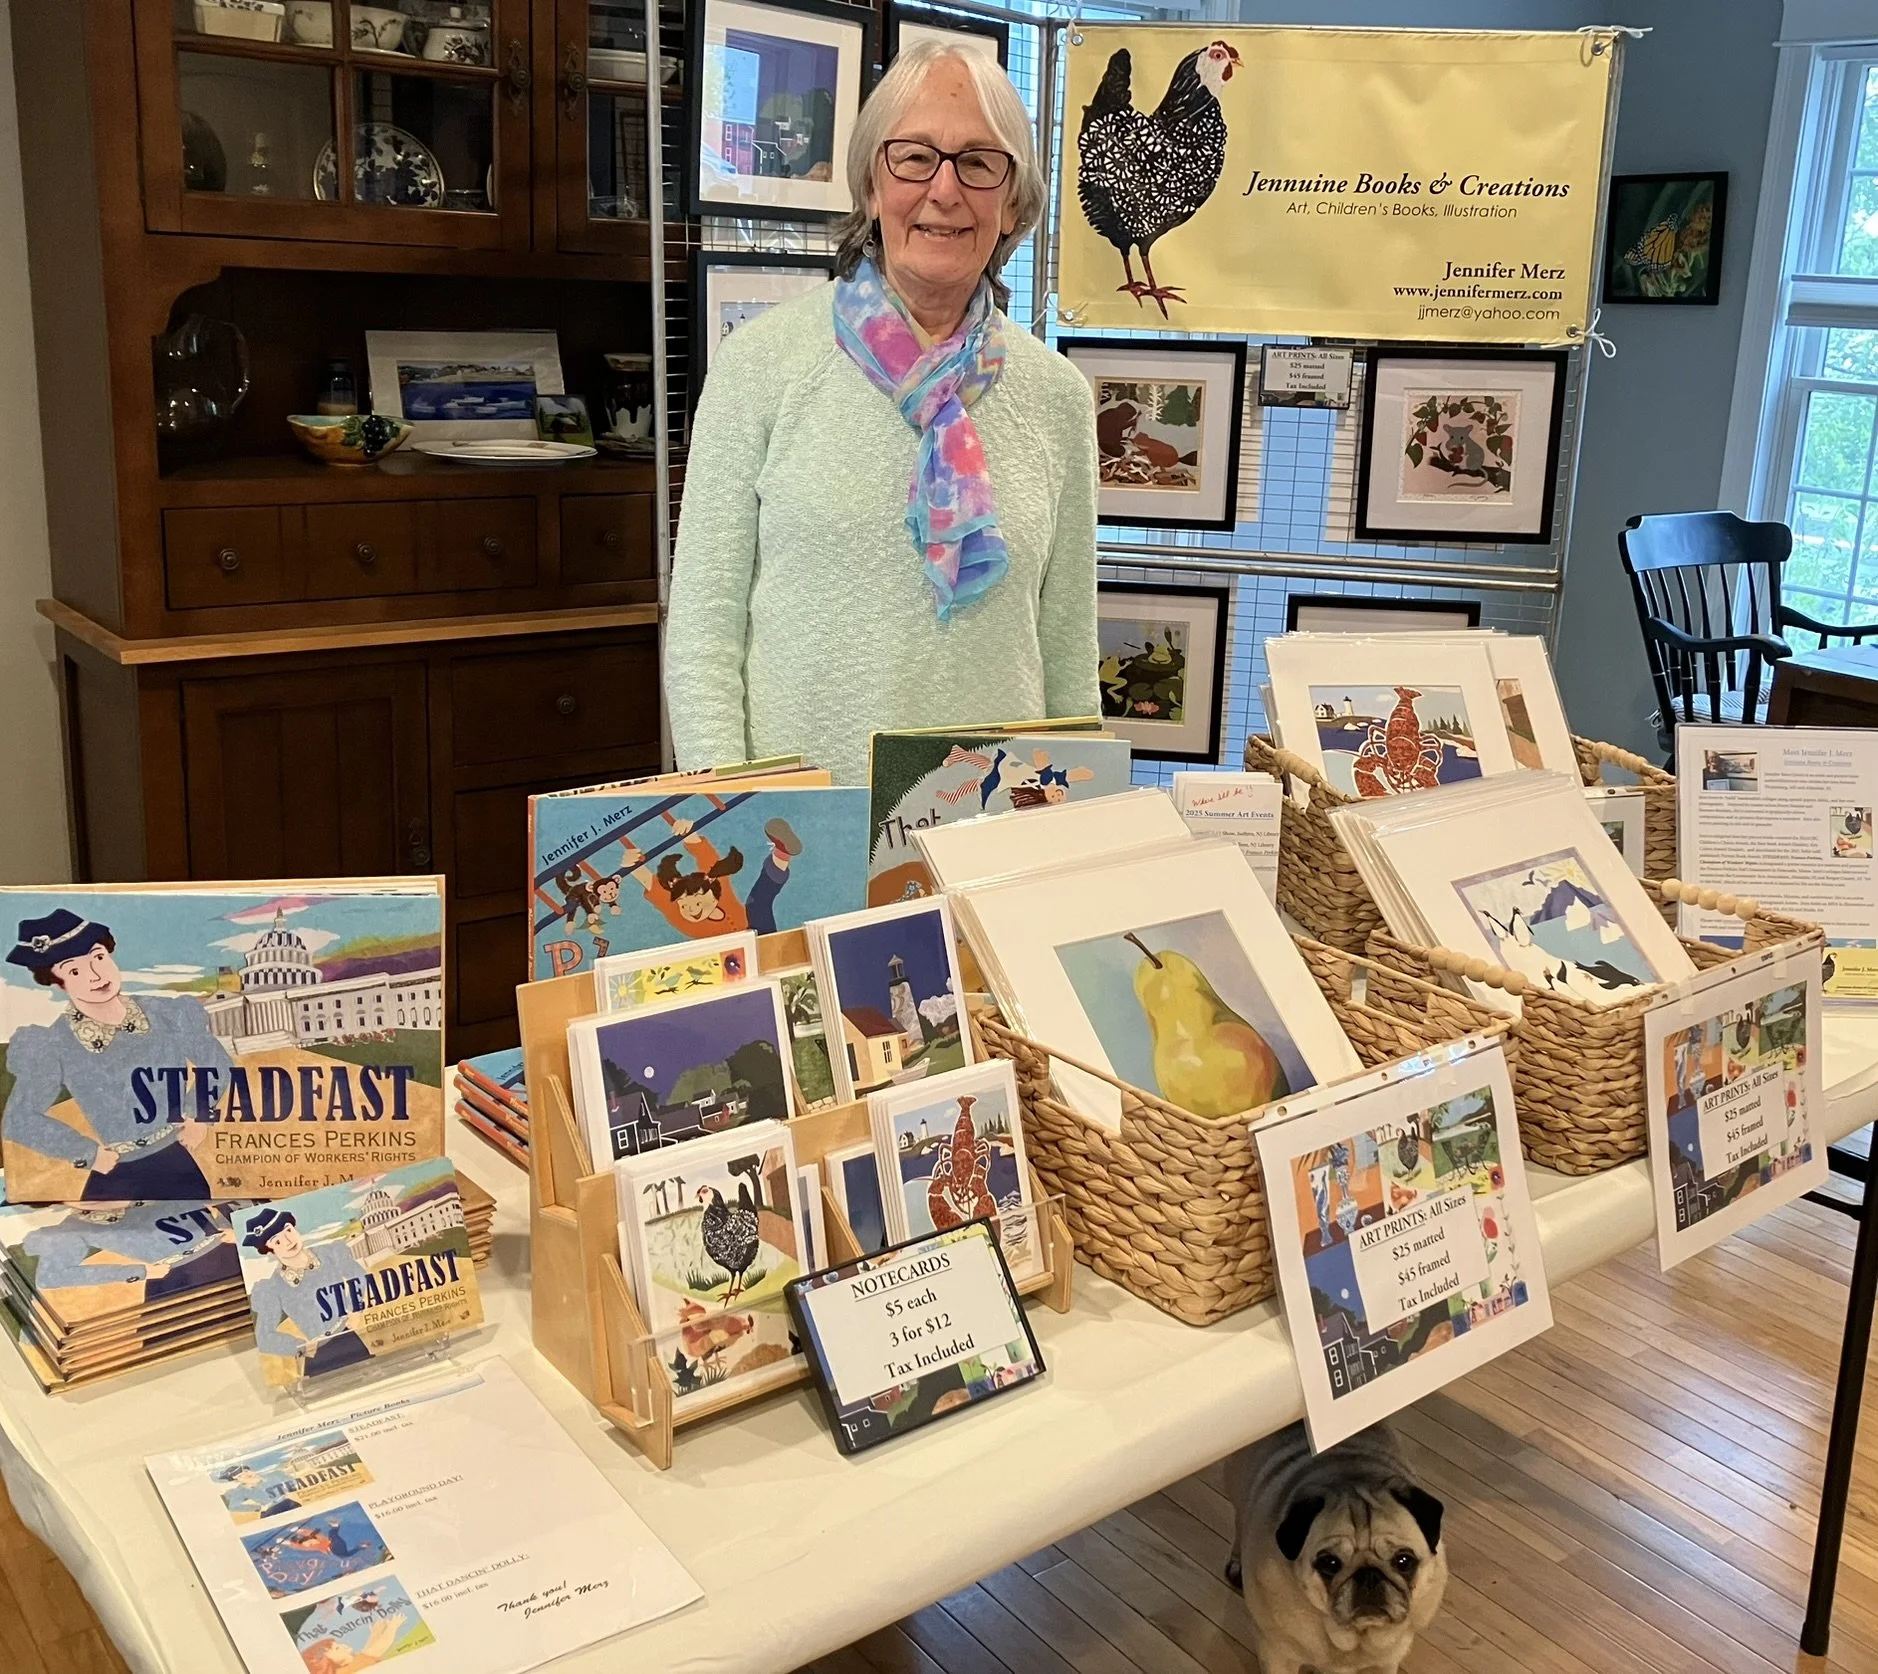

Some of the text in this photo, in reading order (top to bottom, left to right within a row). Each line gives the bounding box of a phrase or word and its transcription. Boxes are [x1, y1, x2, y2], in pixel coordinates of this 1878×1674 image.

[1242, 171, 1570, 197] Jennuine Books & Creations
[1286, 201, 1517, 218] Art, Children's Books, Illustration
[1442, 261, 1566, 281] Jennifer Merz
[1393, 284, 1563, 301] www.jennifermerz.com
[1418, 305, 1560, 322] jjmerz@yahoo.com
[1185, 809, 1203, 817] 2025
[1204, 810, 1235, 818] Summer
[542, 804, 633, 866] Jennifer J. Merz
[131, 1065, 414, 1125] STEADFAST
[1703, 1095, 1719, 1112] ART
[1752, 1074, 1761, 1089] All
[1725, 1095, 1761, 1122] $25 matted
[215, 1131, 417, 1149] FRANCES PERKINS
[1727, 1114, 1763, 1143] $45 framed
[215, 1151, 416, 1165] CHAMPION OF WORKERS' RIGHTS
[1726, 1133, 1768, 1164] Tax Included
[259, 1175, 320, 1189] Jennifer
[1360, 1195, 1466, 1250] ART PRINTS: All Sizes
[1392, 1226, 1445, 1261] $25 matted
[851, 1253, 951, 1299] NOTECARDS
[1398, 1250, 1451, 1286] $45 framed
[316, 1248, 460, 1322] STEADFAST
[1399, 1272, 1460, 1312] Tax Included
[364, 1286, 466, 1325] FRANCES PERKINS
[886, 1288, 938, 1318] $5 each
[889, 1312, 952, 1347] 3 for $12
[884, 1334, 975, 1379] Tax Included
[276, 1425, 314, 1441] Jennifer
[316, 1418, 340, 1430] Merz
[350, 1405, 383, 1419] Picture
[384, 1398, 411, 1410] Books
[265, 1462, 357, 1499] STEADFAST
[369, 1481, 437, 1510] PLAYGROUND
[415, 1581, 444, 1599] THAT
[422, 1594, 453, 1610] $16.00
[497, 1580, 567, 1612] Thank you!
[524, 1594, 572, 1620] Jennifer
